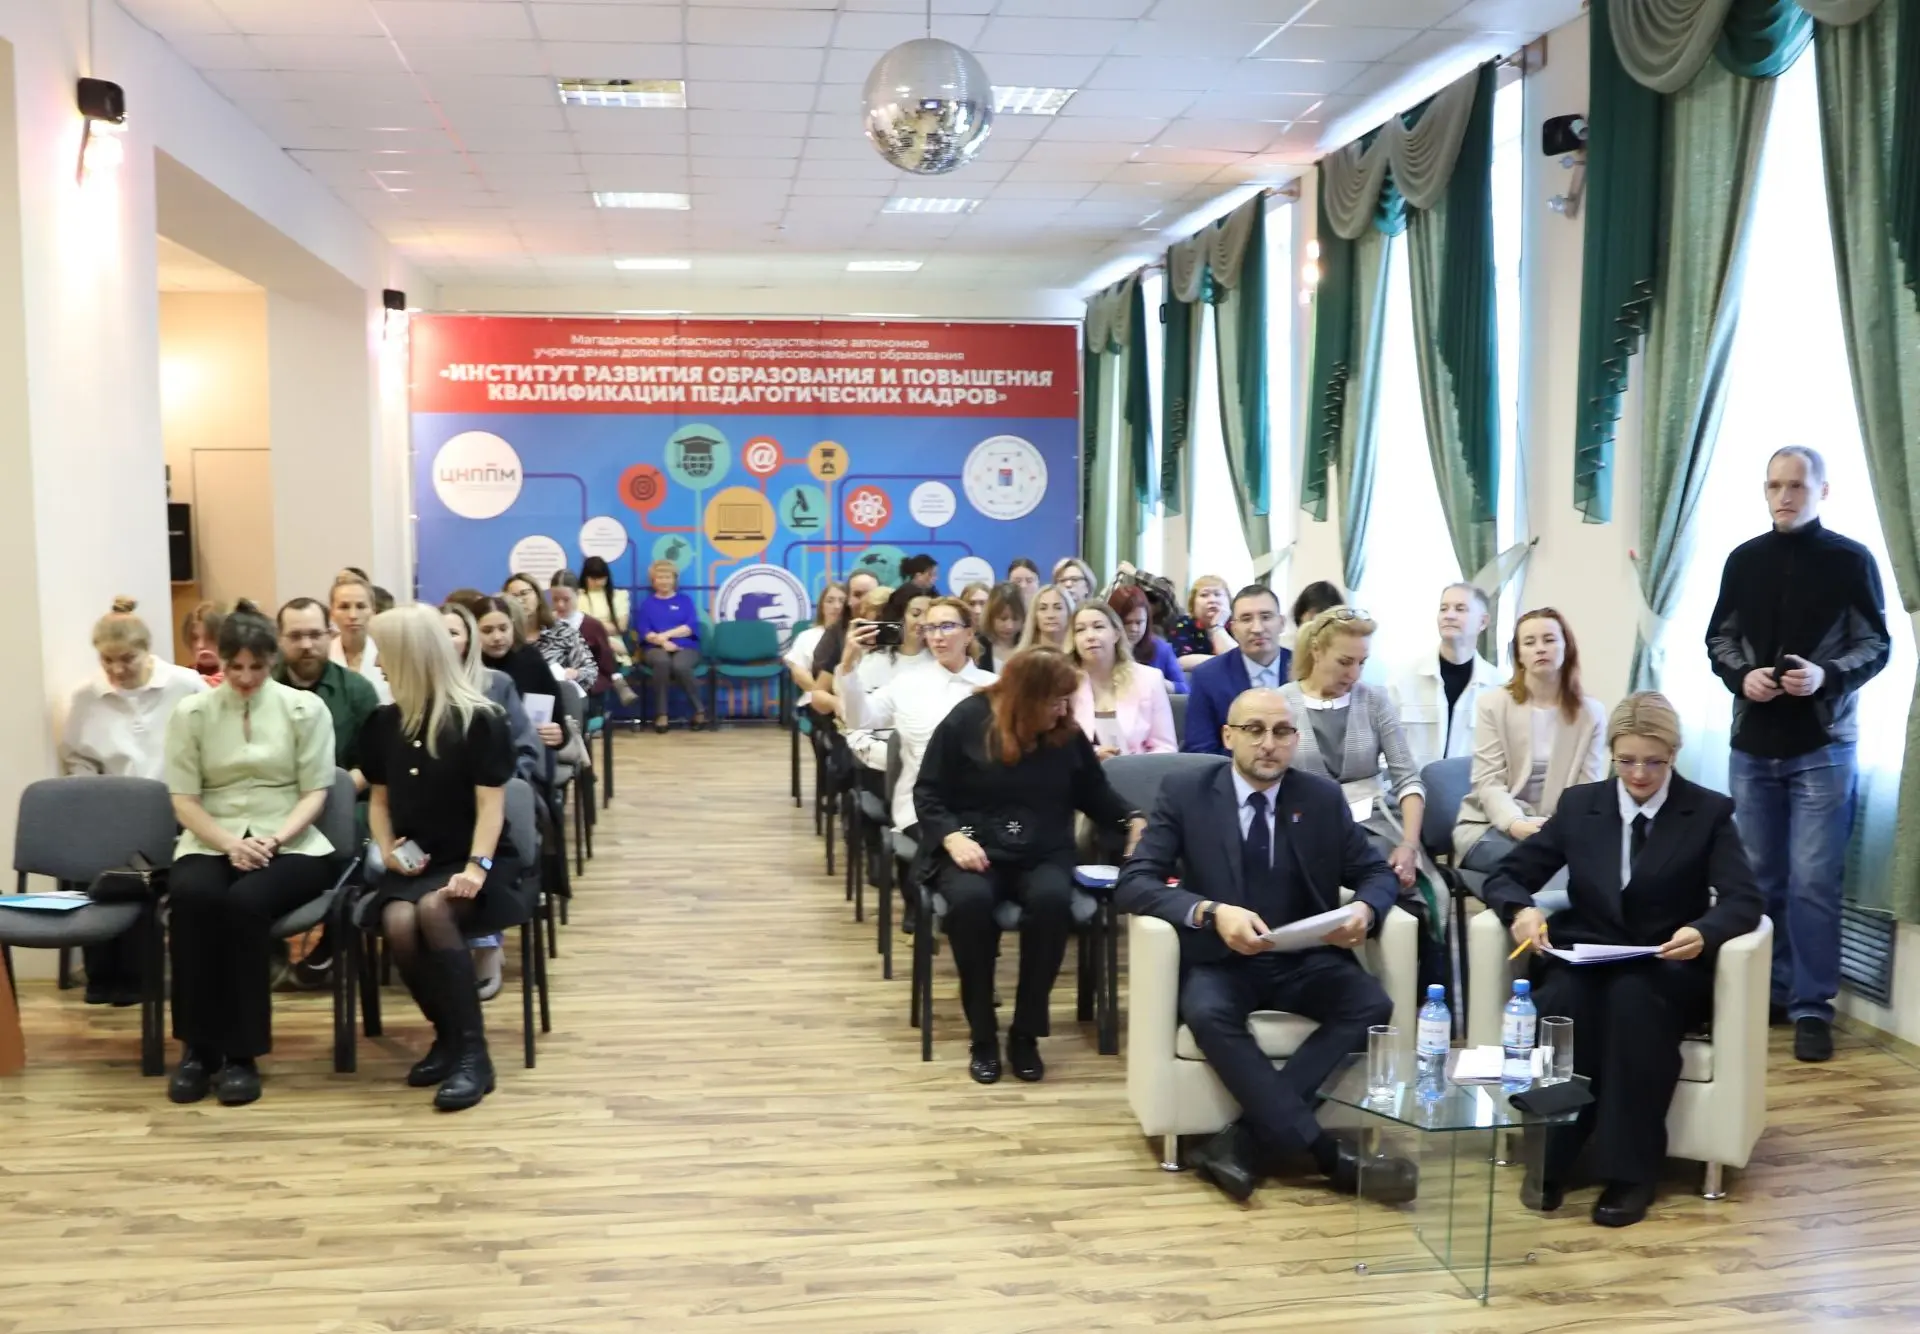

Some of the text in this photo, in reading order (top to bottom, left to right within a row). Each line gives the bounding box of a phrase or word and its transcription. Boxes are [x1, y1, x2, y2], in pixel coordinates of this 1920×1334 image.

[439, 363, 1054, 387] «ИНСТИТУТ РАЗВИТИЯ ОБРАЗОВАНИЯ И ПОВЫШЕНИЯ
[487, 383, 1007, 407] КВАЛИФИКАЦИИ ПЕДАГОГИЧЕСКИХ КАДРОВ»
